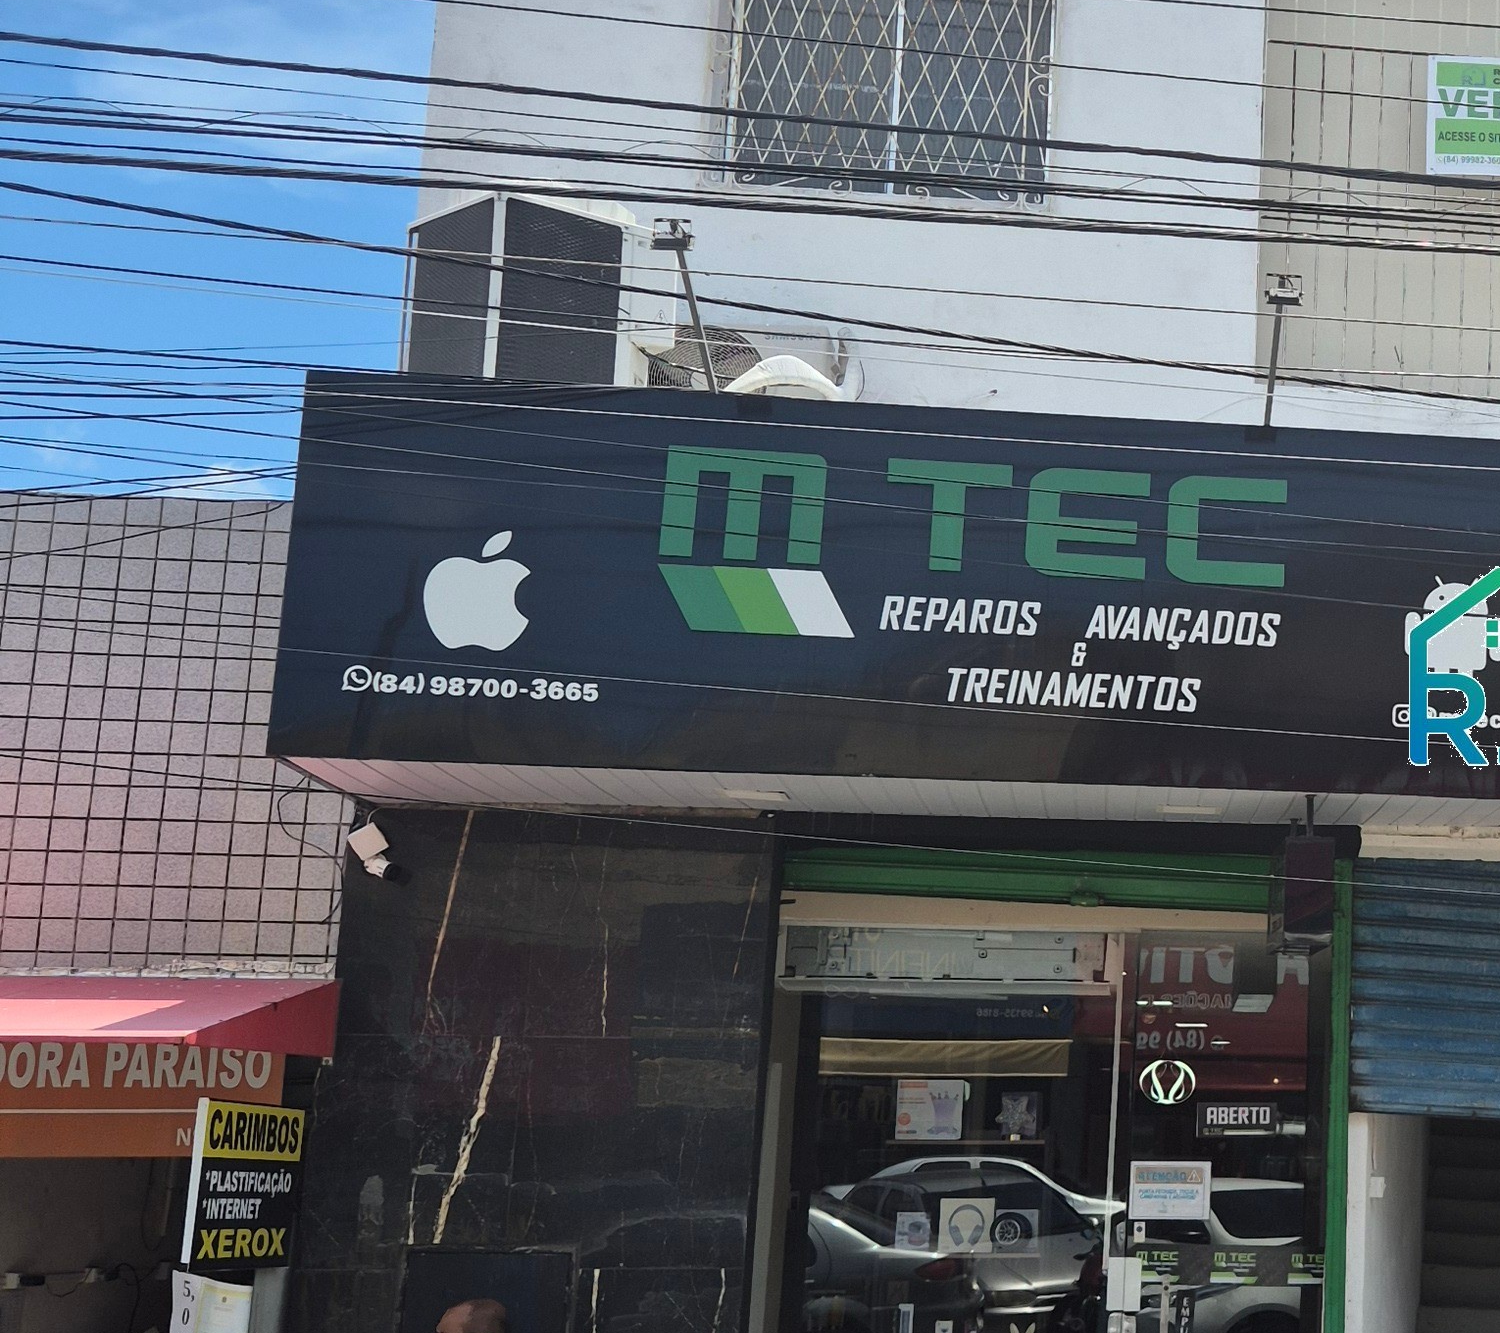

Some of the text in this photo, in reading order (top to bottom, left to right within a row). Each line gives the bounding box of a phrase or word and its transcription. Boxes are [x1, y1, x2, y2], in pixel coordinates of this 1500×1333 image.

[1438, 131, 1476, 142] ACESSE
[1478, 132, 1486, 142] O
[888, 458, 1288, 588] TEC
[879, 595, 1281, 650] REPAROS AVANÇADOS
[1071, 641, 1087, 667] &
[372, 671, 599, 701] (84) 98700-3665
[946, 668, 1201, 713] TREINAMENTOS
[0, 1042, 90, 1089] ORA
[1206, 1106, 1271, 1125] ABERTO
[209, 1109, 300, 1154] CARIMBOS
[196, 1228, 287, 1259] XEROX
[1151, 1251, 1179, 1262] TEC
[1230, 1252, 1256, 1263] TEC
